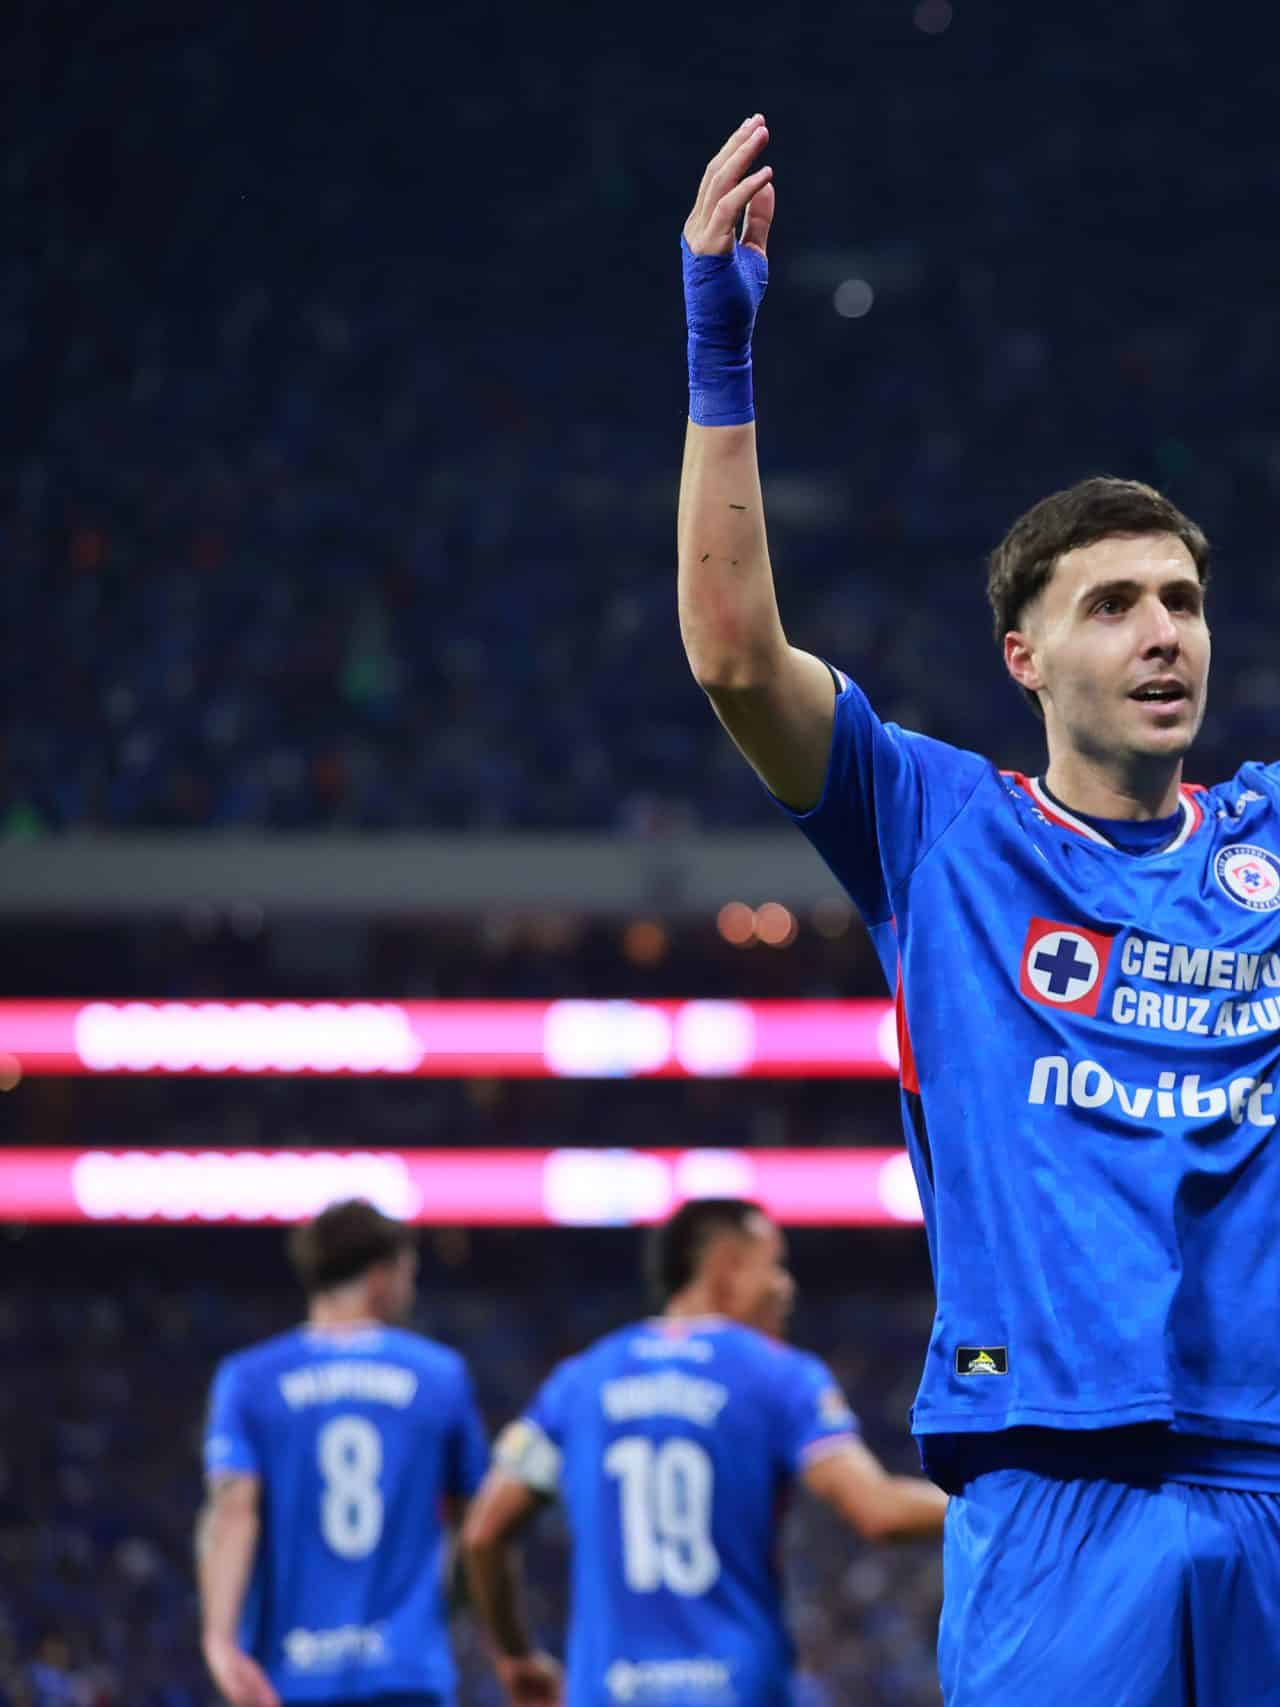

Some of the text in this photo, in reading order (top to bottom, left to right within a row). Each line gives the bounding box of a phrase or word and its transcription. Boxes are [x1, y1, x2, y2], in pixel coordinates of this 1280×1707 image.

[1112, 986, 1208, 1034] CRUZ
[318, 1416, 383, 1558] 8
[604, 1437, 720, 1596] 19
